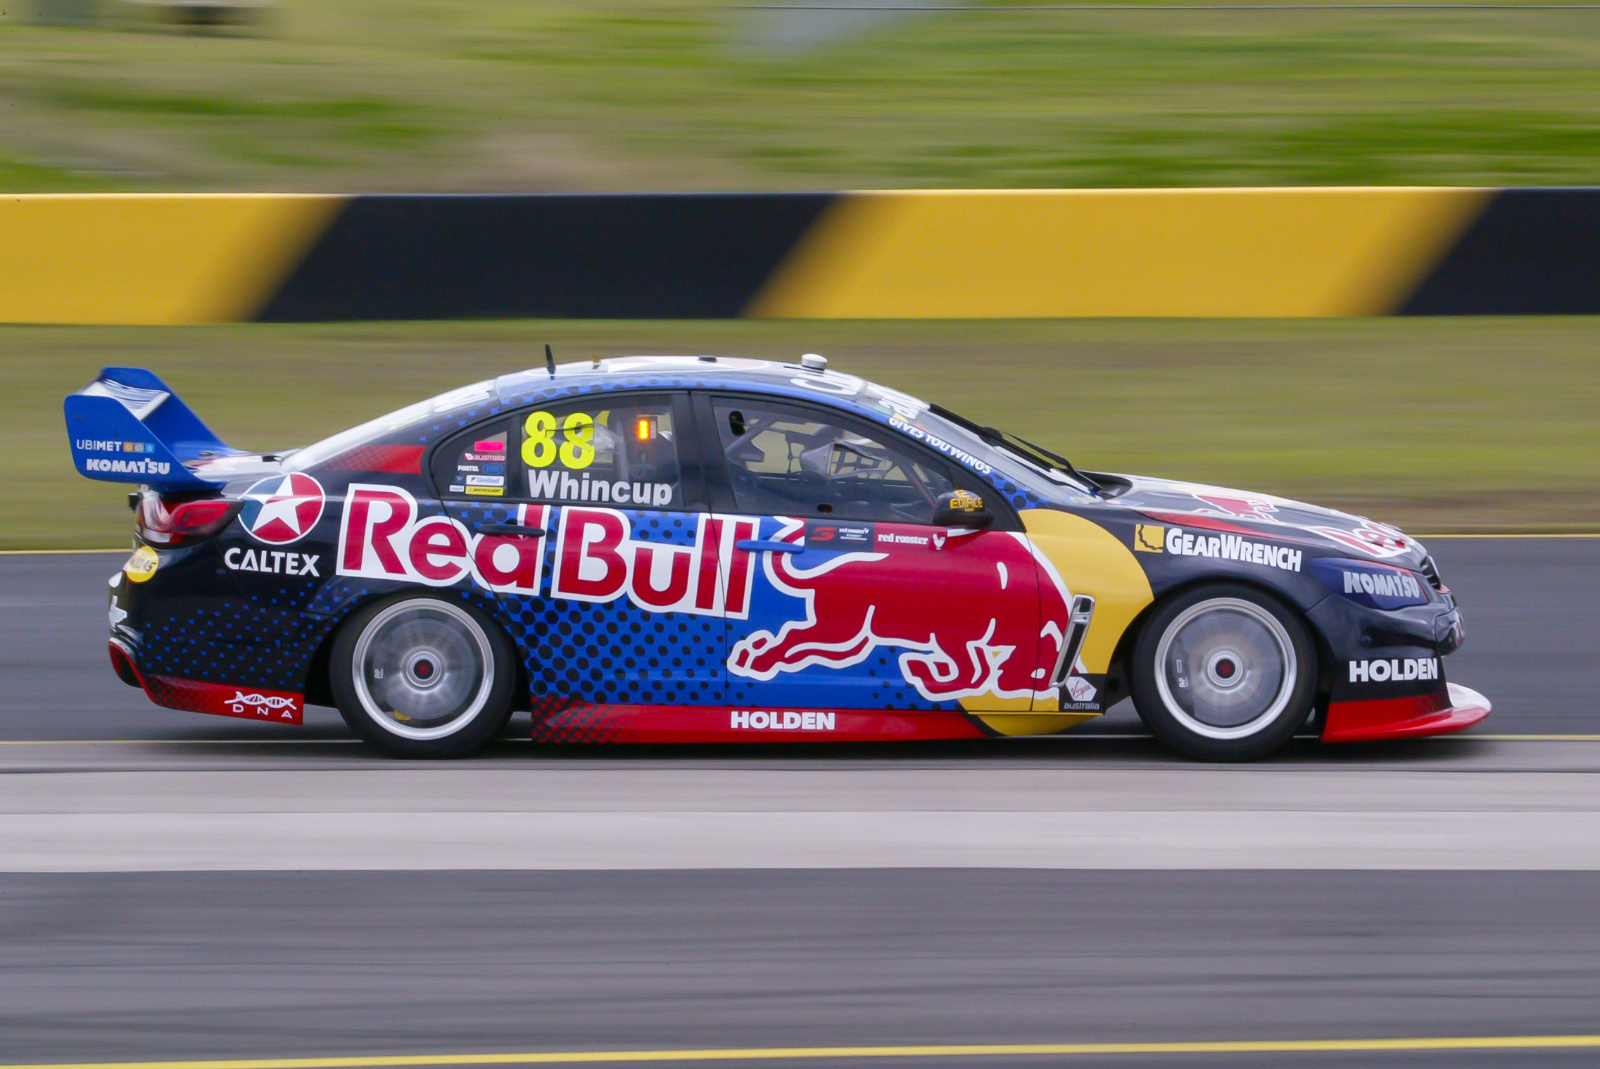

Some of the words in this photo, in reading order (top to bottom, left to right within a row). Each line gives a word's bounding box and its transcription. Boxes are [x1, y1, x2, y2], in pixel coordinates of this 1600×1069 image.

[76, 438, 122, 452] UBIMET
[521, 411, 595, 469] 88
[888, 417, 925, 439] GIVES
[924, 433, 952, 452] YOU
[949, 446, 992, 475] WINGS
[87, 458, 170, 474] KOMATSU
[527, 469, 673, 506] Whincup
[336, 484, 551, 596] Red
[550, 505, 761, 620] Bull
[878, 533, 894, 542] red
[895, 535, 928, 545] rooster
[224, 547, 320, 577] CALTEX
[1343, 570, 1420, 598] KOMATSU
[1349, 658, 1438, 683] HOLDEN
[1063, 702, 1100, 710] australia
[730, 711, 836, 730] HOLDEN
